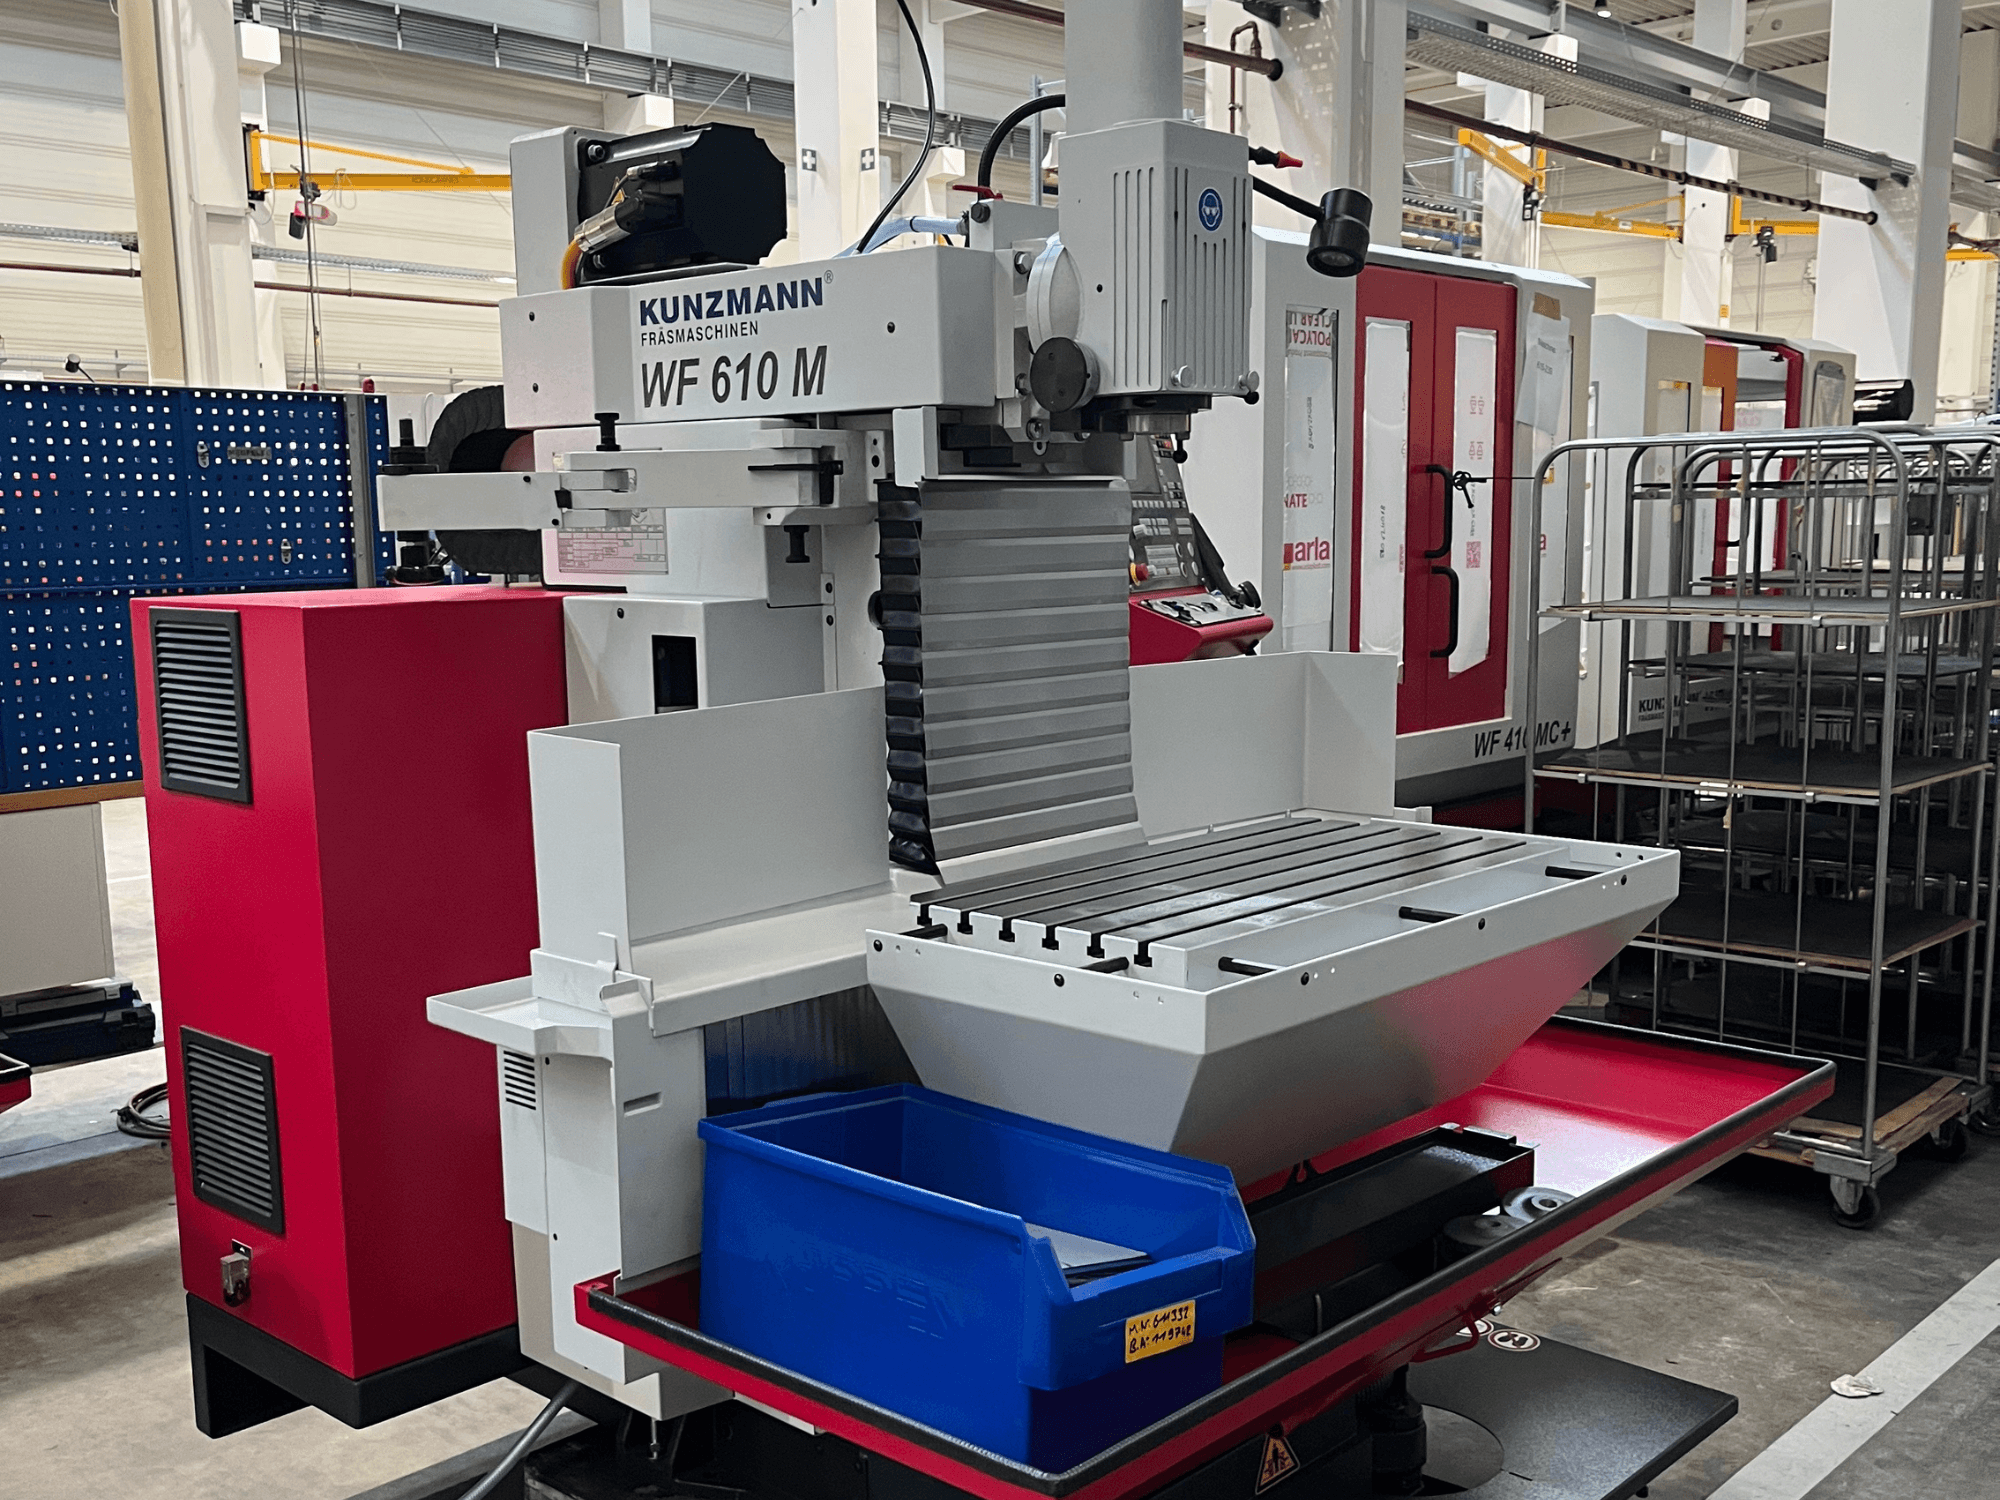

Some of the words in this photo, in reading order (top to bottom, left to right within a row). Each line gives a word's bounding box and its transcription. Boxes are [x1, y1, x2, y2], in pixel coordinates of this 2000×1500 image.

[641, 320, 759, 346] FRÄSMASCHINEN
[642, 358, 700, 408] WF
[711, 350, 778, 403] 610
[792, 345, 828, 397] M
[1295, 536, 1330, 561] arla
[1475, 730, 1501, 758] WF
